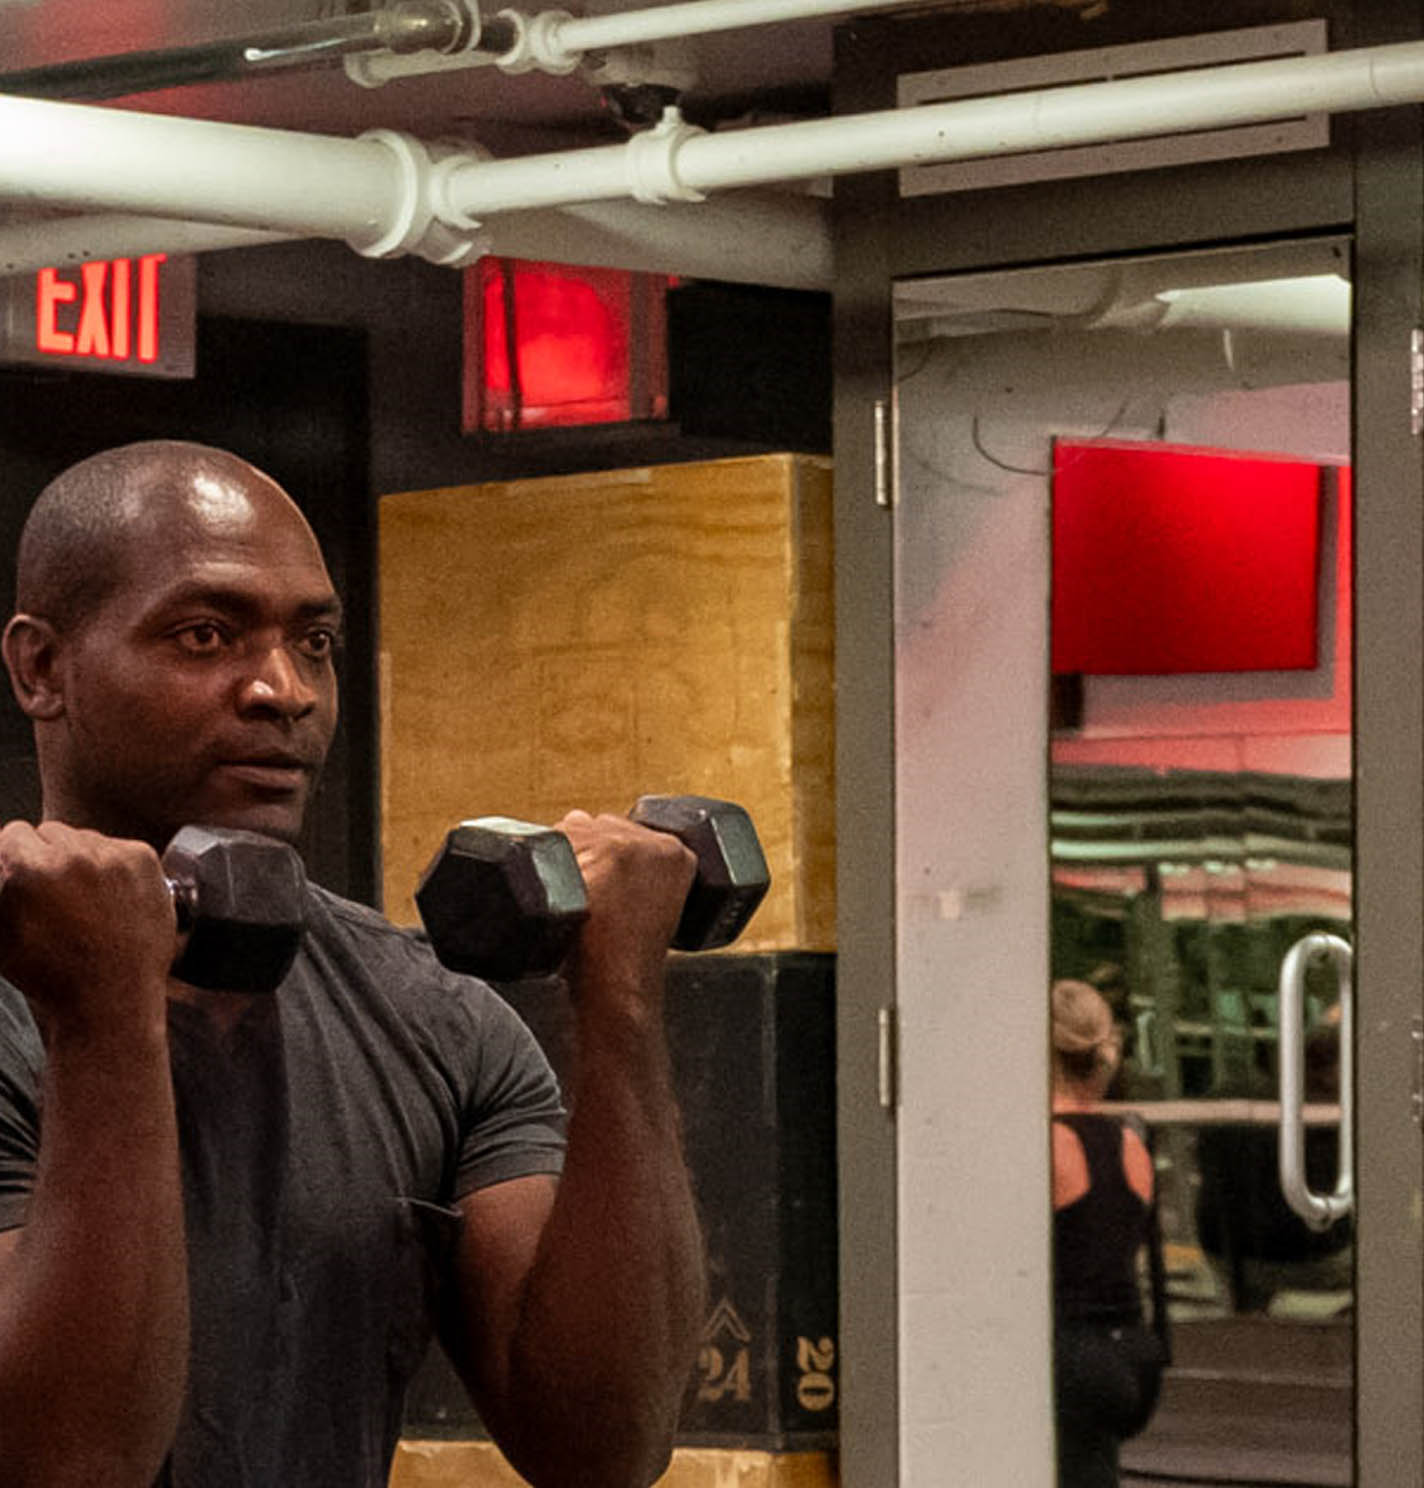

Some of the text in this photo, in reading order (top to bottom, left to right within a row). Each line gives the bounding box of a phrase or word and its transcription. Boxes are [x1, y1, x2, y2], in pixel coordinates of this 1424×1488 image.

[37, 254, 168, 364] EXIT
[697, 1346, 751, 1401] 24
[796, 1336, 835, 1411] 20
